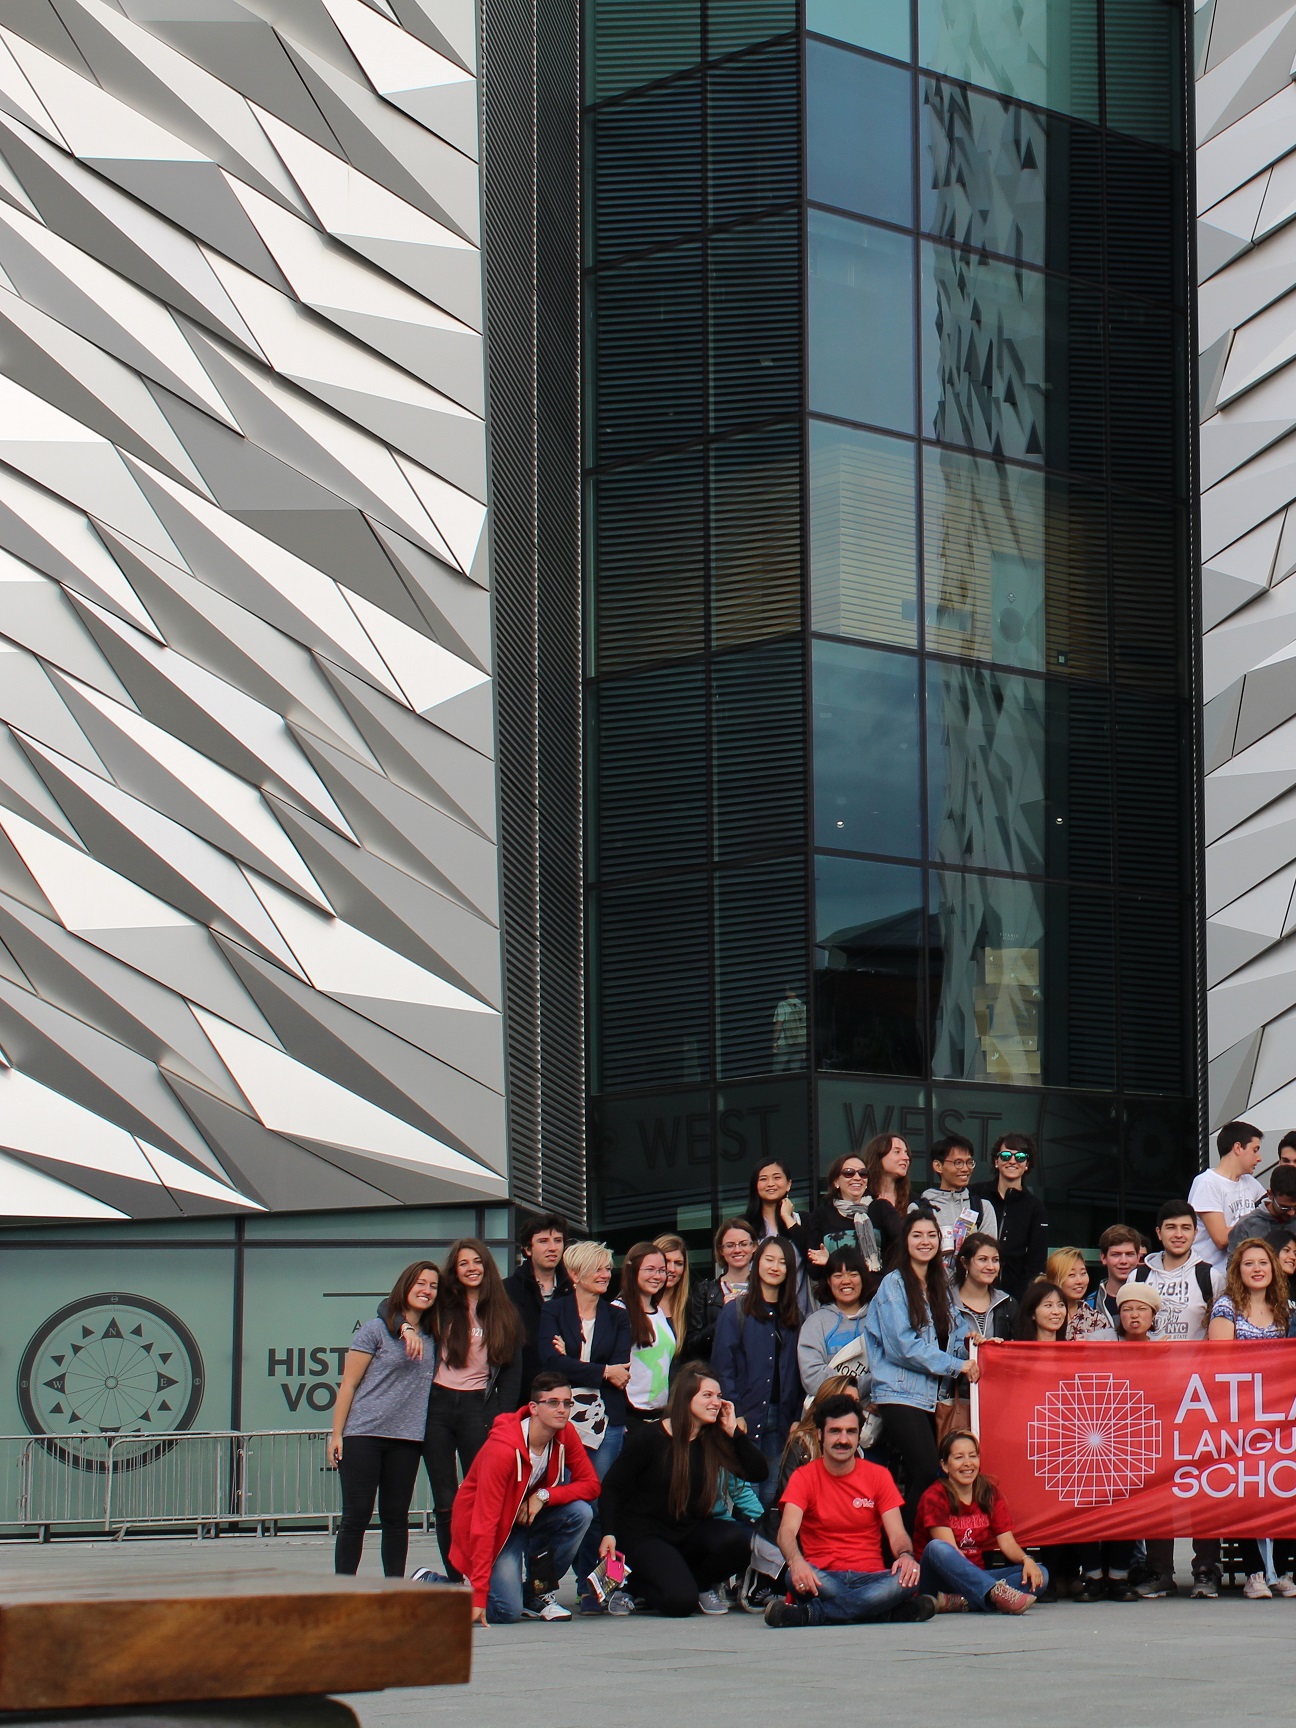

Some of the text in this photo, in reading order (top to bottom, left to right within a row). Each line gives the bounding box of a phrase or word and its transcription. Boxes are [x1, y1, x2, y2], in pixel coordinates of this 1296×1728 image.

[637, 1104, 781, 1169] WEST
[842, 1103, 1002, 1162] WEST
[109, 1328, 117, 1336] N
[1167, 1323, 1187, 1333] NYC
[53, 1380, 63, 1389] W
[160, 1378, 167, 1387] E
[281, 1382, 343, 1412] VO
